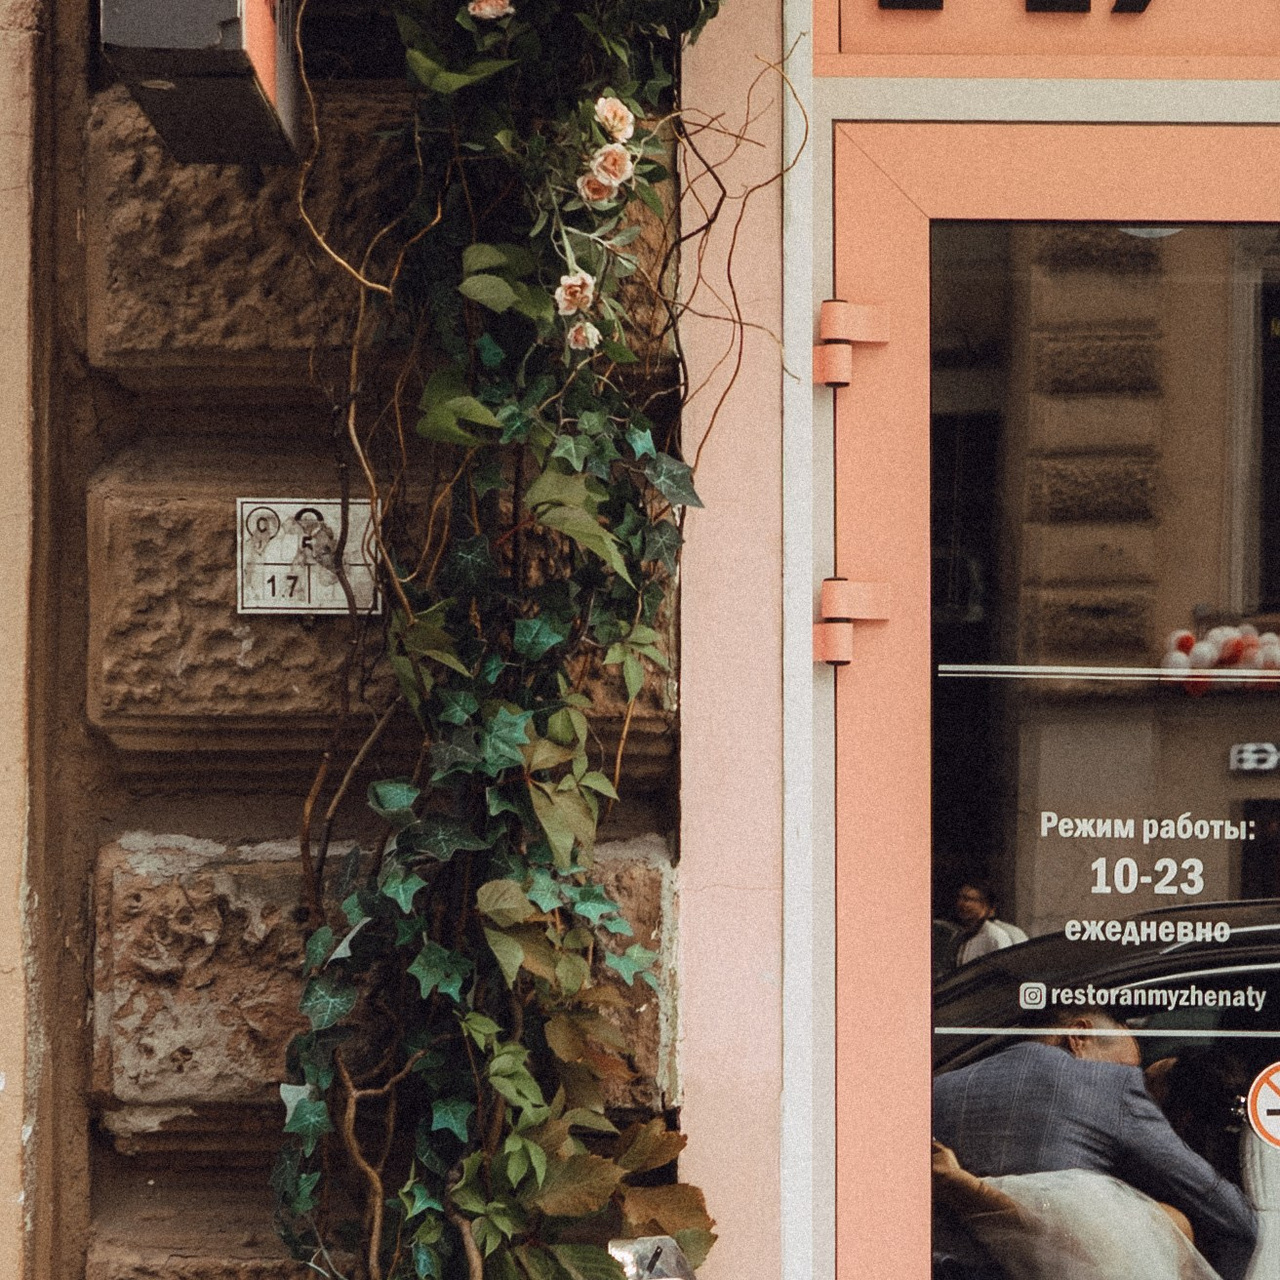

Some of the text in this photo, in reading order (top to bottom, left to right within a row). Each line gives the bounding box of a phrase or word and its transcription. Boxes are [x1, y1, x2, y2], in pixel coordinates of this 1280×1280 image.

[1040, 811, 1256, 844] Режим работы:
[1090, 856, 1206, 896] 10-23
[1065, 920, 1231, 945] ежедневно
[1051, 982, 1267, 1011] restoranmyzhenaty
